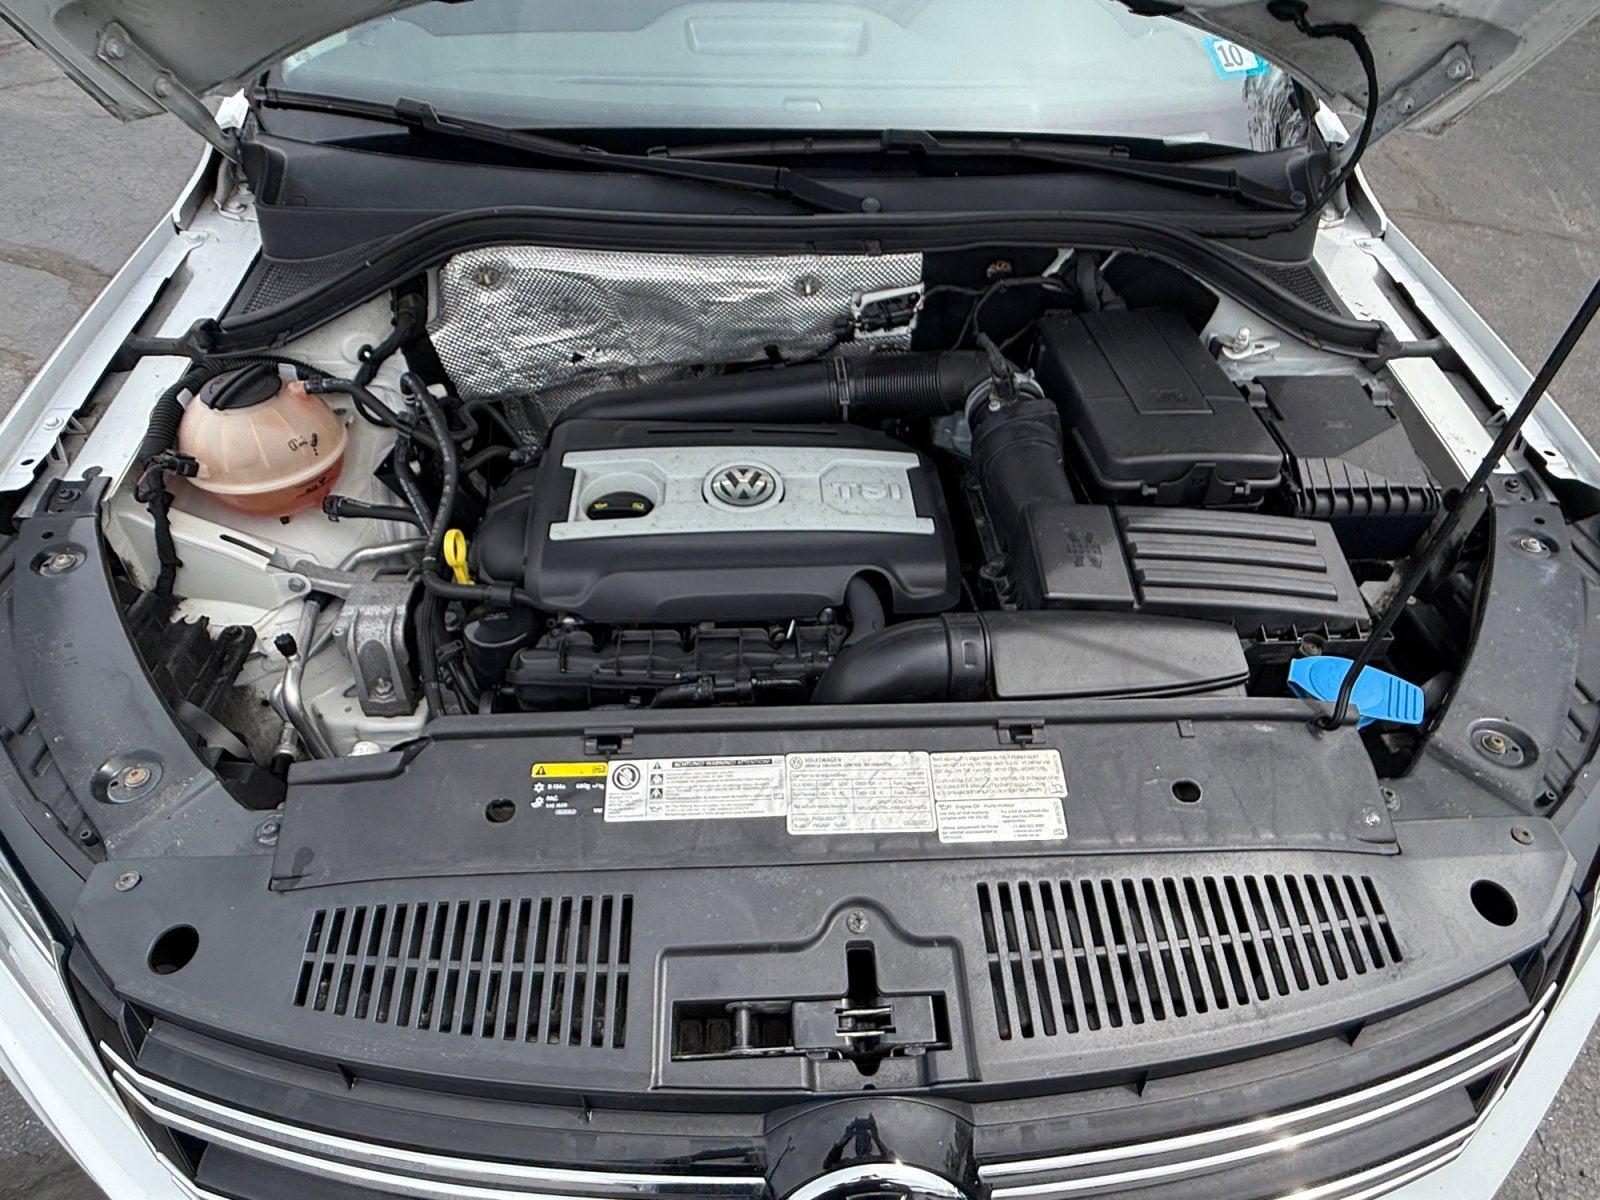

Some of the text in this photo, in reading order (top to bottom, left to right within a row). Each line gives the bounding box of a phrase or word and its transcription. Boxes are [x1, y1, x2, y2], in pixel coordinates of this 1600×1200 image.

[1217, 44, 1244, 67] 10
[713, 466, 776, 505] VW
[829, 481, 903, 500] TSI
